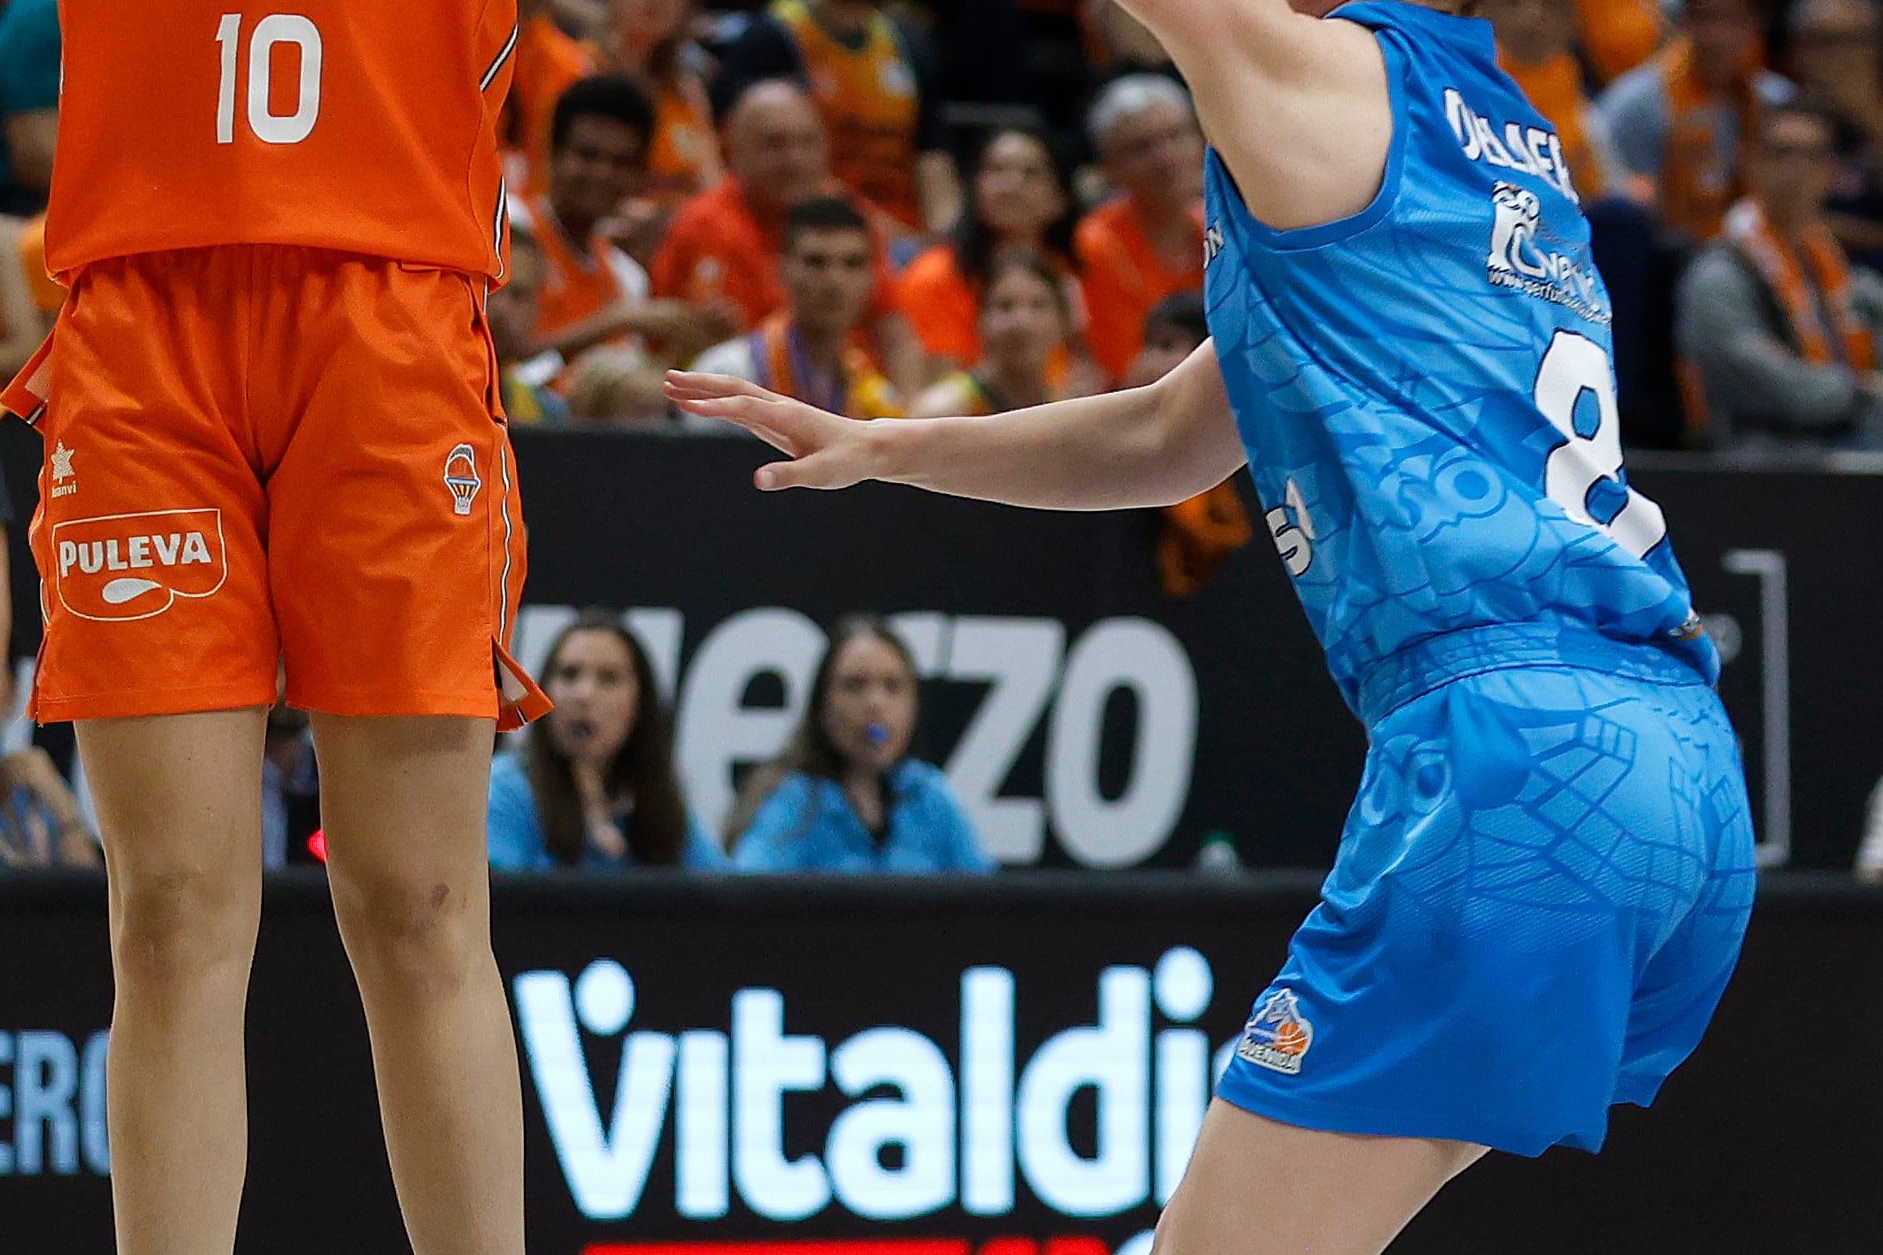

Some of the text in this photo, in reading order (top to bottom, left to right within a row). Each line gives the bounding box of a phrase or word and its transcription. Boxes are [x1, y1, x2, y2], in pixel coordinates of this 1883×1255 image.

[216, 13, 323, 144] 10
[1534, 328, 1667, 558] 8
[59, 532, 211, 578] PULEVA
[513, 947, 1236, 1221] Vitaldi
